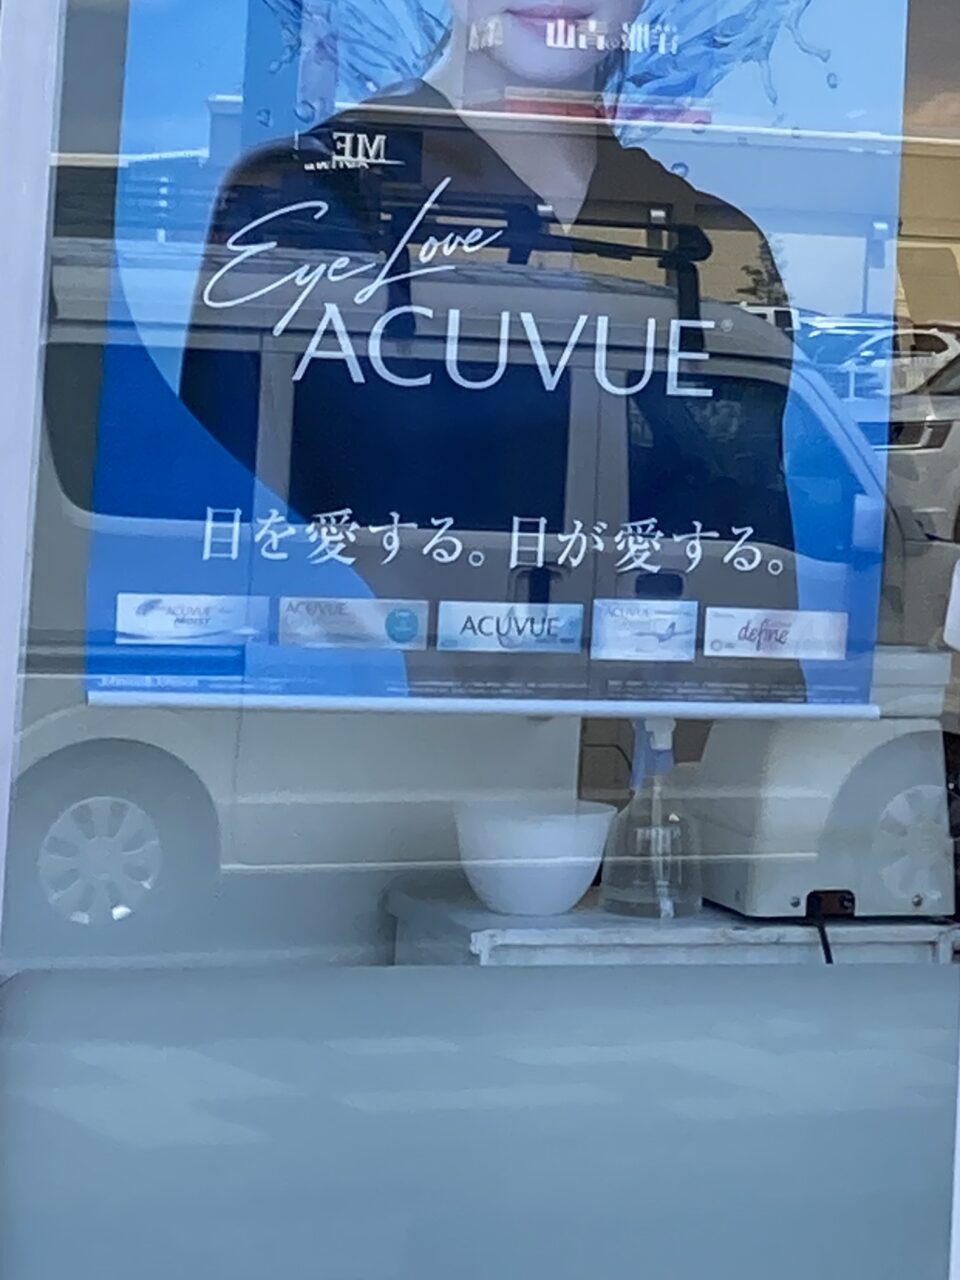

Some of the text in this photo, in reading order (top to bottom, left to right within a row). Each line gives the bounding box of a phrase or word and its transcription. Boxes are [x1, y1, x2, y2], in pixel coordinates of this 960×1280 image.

[202, 176, 506, 336] Eye Love
[292, 303, 715, 399] ACUVUE
[459, 615, 559, 638] ACUVUE
